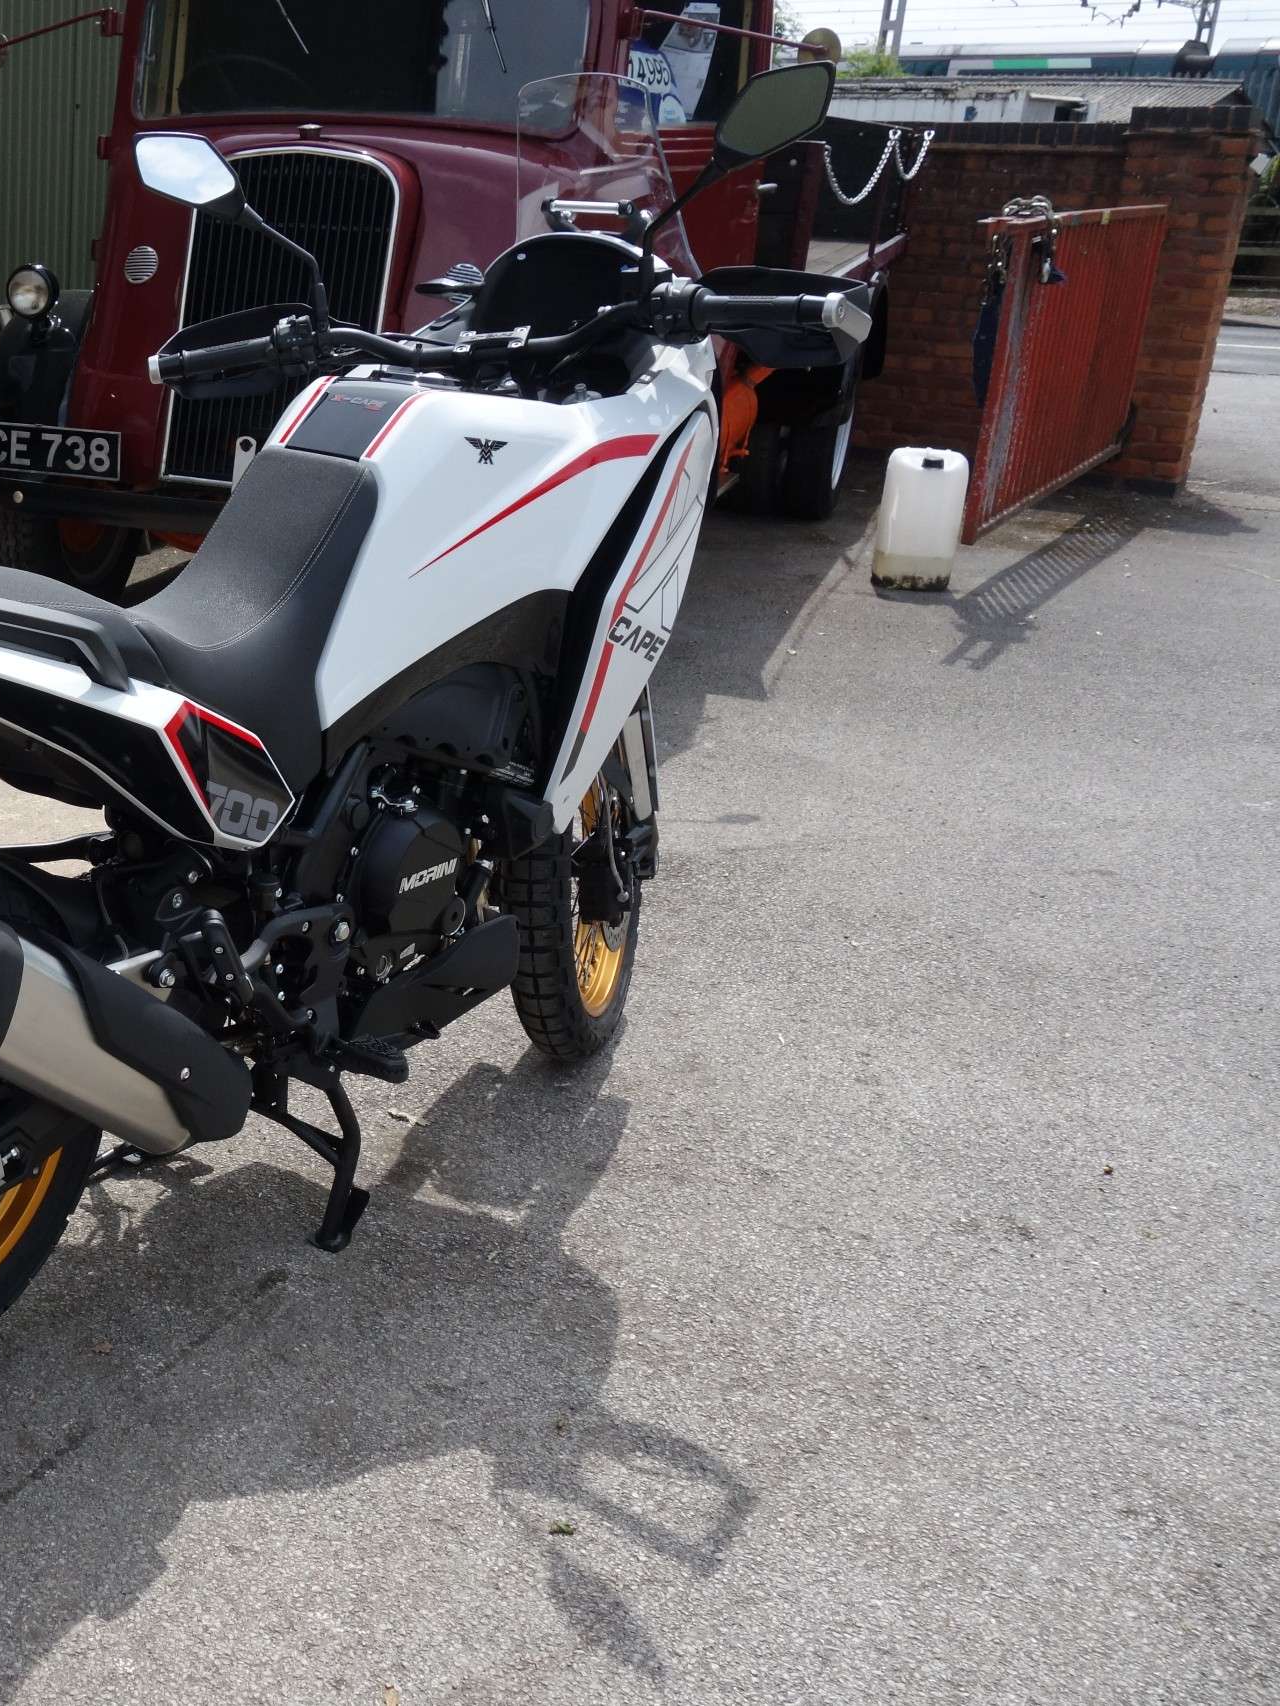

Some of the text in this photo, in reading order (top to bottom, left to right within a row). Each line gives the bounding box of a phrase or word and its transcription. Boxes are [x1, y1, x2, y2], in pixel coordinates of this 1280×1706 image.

[41, 433, 111, 473] 738
[608, 615, 667, 662] CAPE
[206, 780, 279, 842] 700
[398, 857, 458, 894] MORINI
